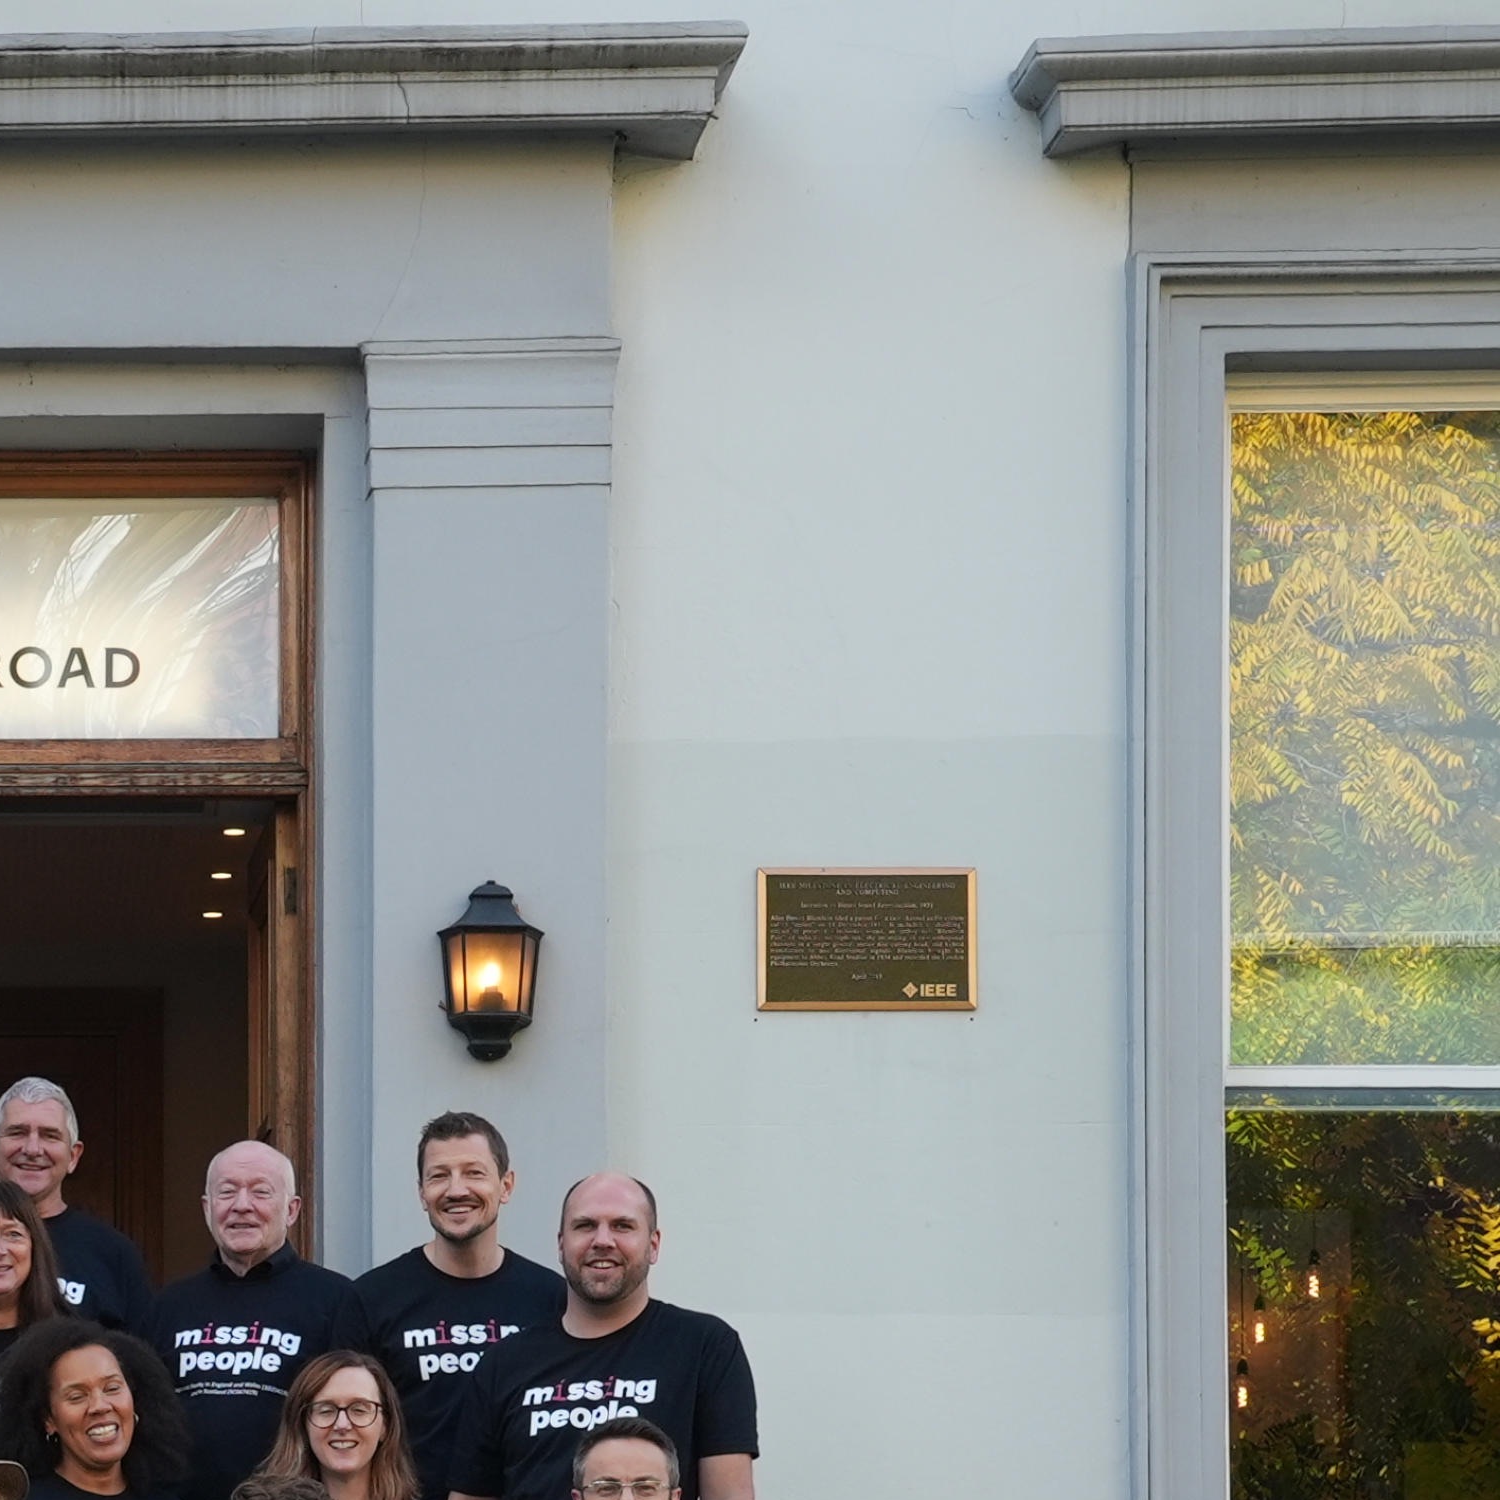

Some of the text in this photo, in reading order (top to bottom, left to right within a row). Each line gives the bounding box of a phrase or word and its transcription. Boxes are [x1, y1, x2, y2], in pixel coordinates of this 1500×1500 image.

[920, 984, 957, 997] IEEE
[174, 1321, 302, 1355] missing
[403, 1319, 522, 1348] missin
[179, 1347, 282, 1377] people
[419, 1351, 484, 1381] peo
[522, 1375, 657, 1406] missing
